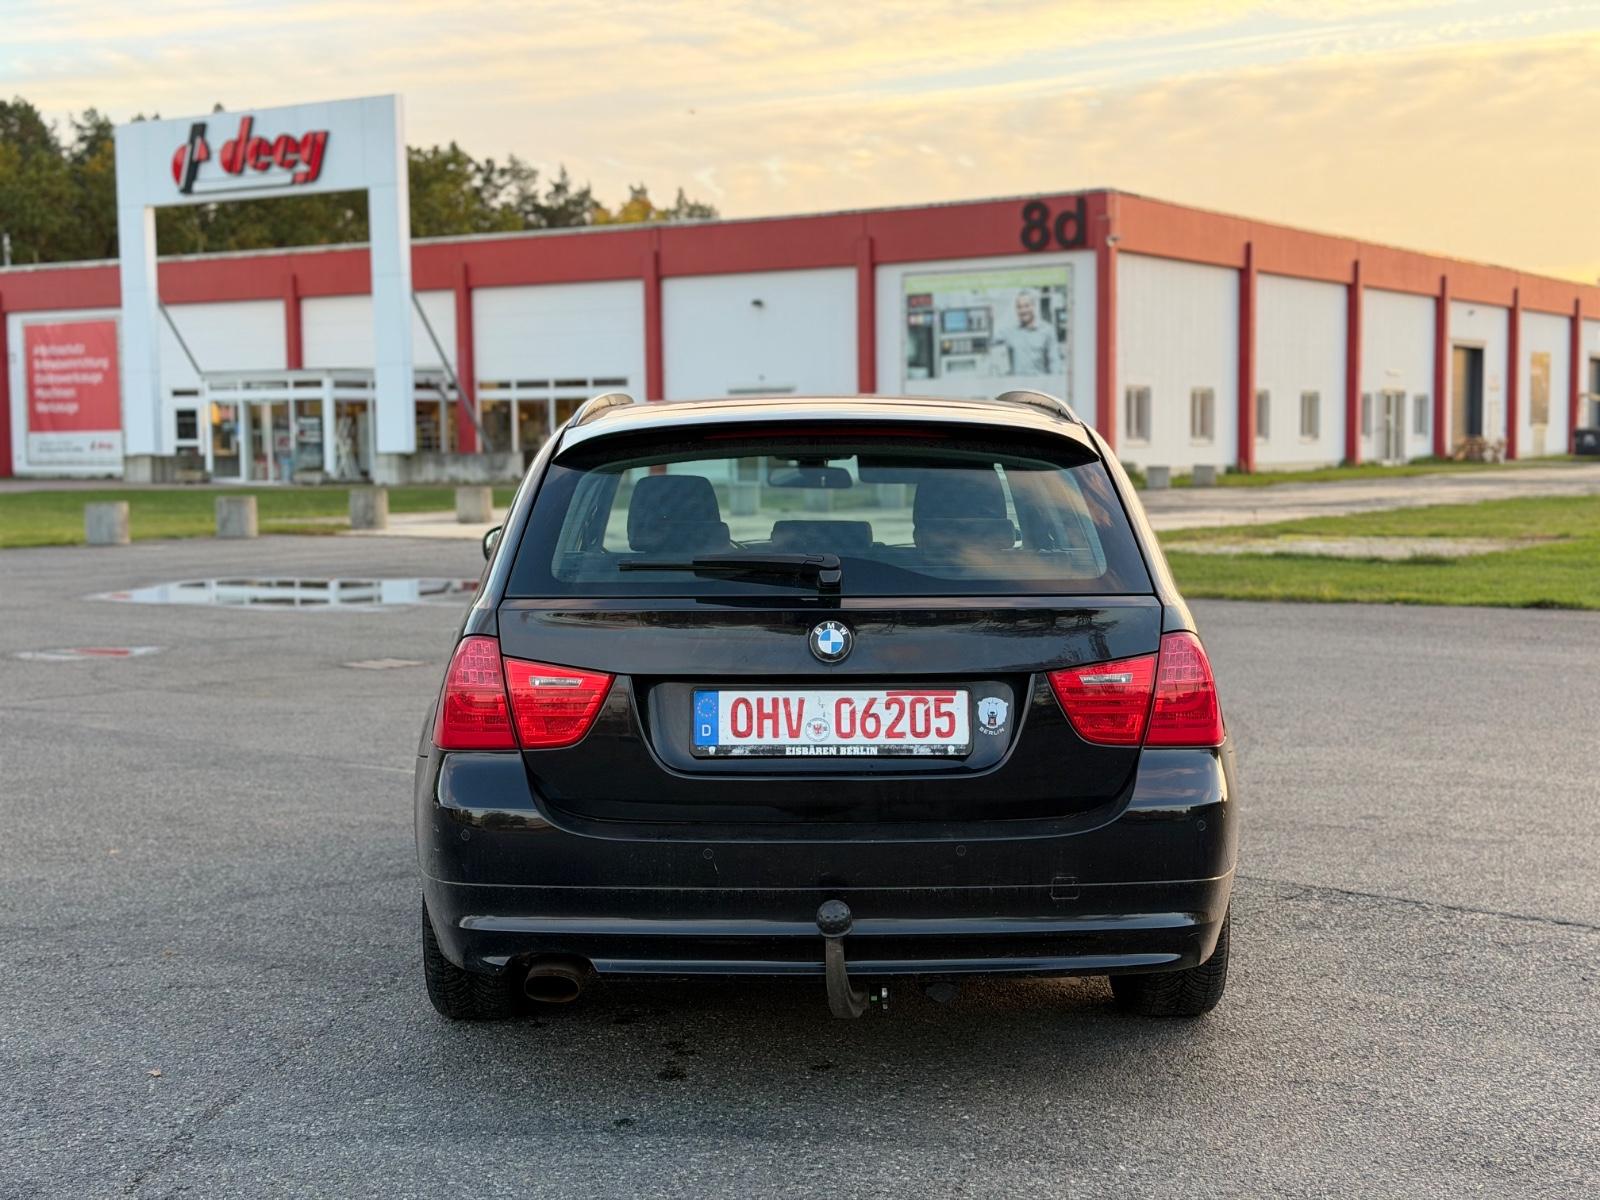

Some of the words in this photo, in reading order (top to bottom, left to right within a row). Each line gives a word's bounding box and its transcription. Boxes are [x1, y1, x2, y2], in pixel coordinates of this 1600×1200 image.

[220, 115, 329, 185] deeg
[1021, 197, 1087, 251] 8d
[814, 622, 848, 635] BMW
[730, 697, 805, 739] OHV
[835, 697, 955, 739] 06205
[701, 725, 711, 736] D
[979, 726, 1005, 736] BERLIN
[839, 746, 878, 756] BERLIN
